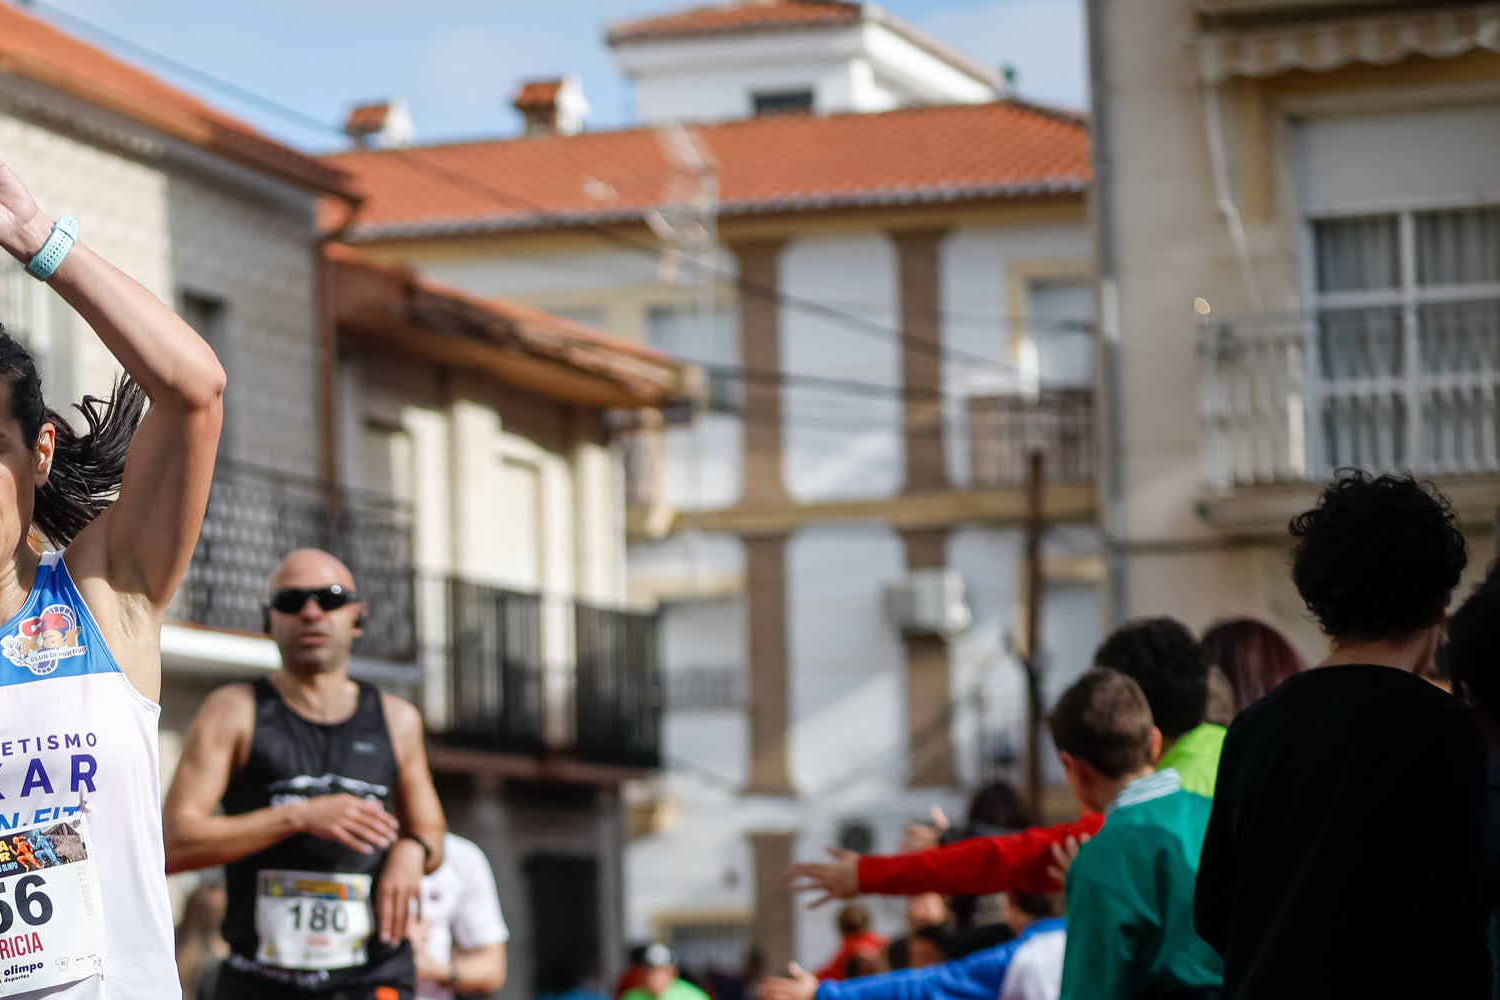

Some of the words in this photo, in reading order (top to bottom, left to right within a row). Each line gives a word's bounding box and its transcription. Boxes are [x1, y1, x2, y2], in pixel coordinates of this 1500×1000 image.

[30, 652, 49, 662] CLUB
[49, 647, 87, 657] DEPORTIVO
[2, 861, 19, 872] OLIMPO
[288, 902, 349, 933] 180
[3, 961, 44, 976] olimpo
[3, 974, 30, 983] deportes
